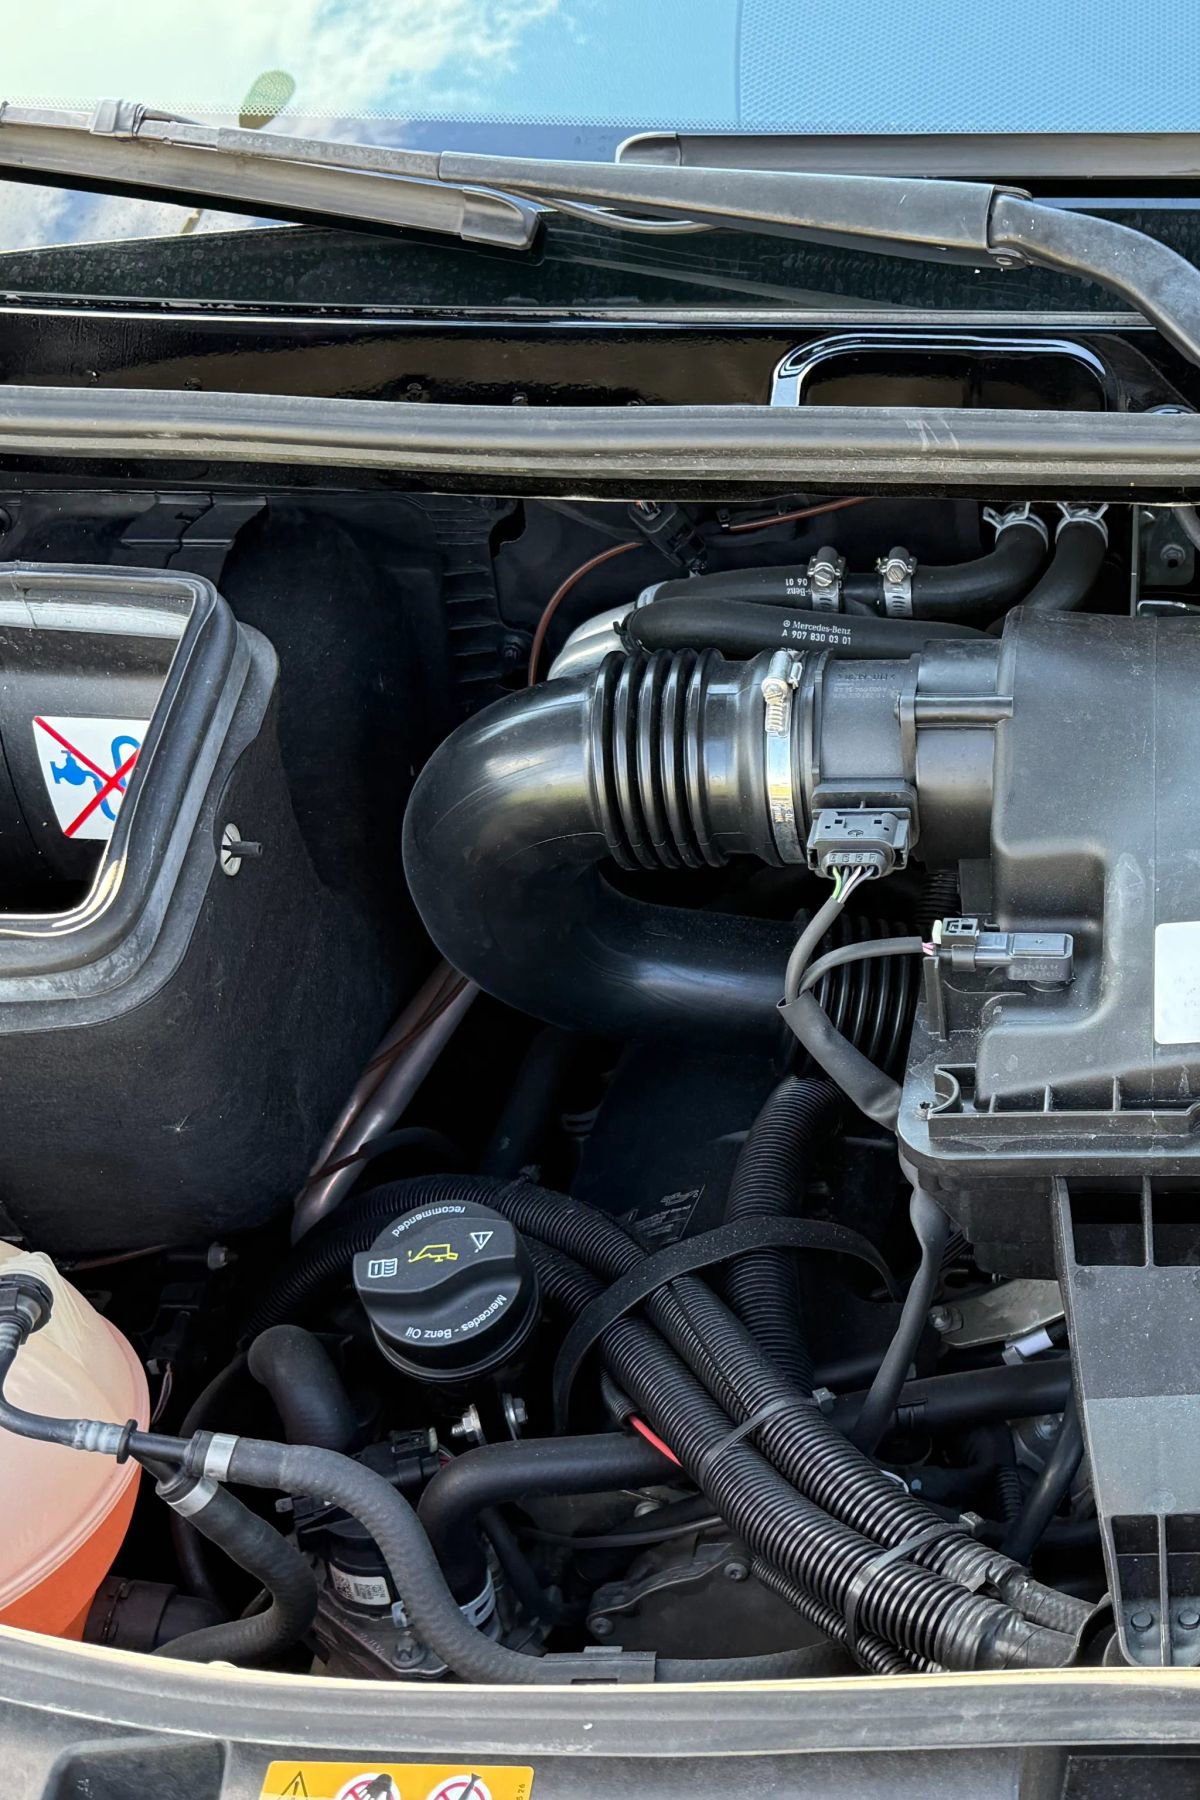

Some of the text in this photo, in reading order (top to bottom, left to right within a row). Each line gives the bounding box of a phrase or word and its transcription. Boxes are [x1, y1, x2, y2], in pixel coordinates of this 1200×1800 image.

[792, 620, 852, 635] Mercedes-Benz
[782, 629, 852, 645] A 907 830 03 01
[392, 1205, 466, 1238] recommended
[461, 1294, 508, 1332] Mercedes
[405, 1326, 422, 1339] Oil
[424, 1328, 453, 1339] Benz
